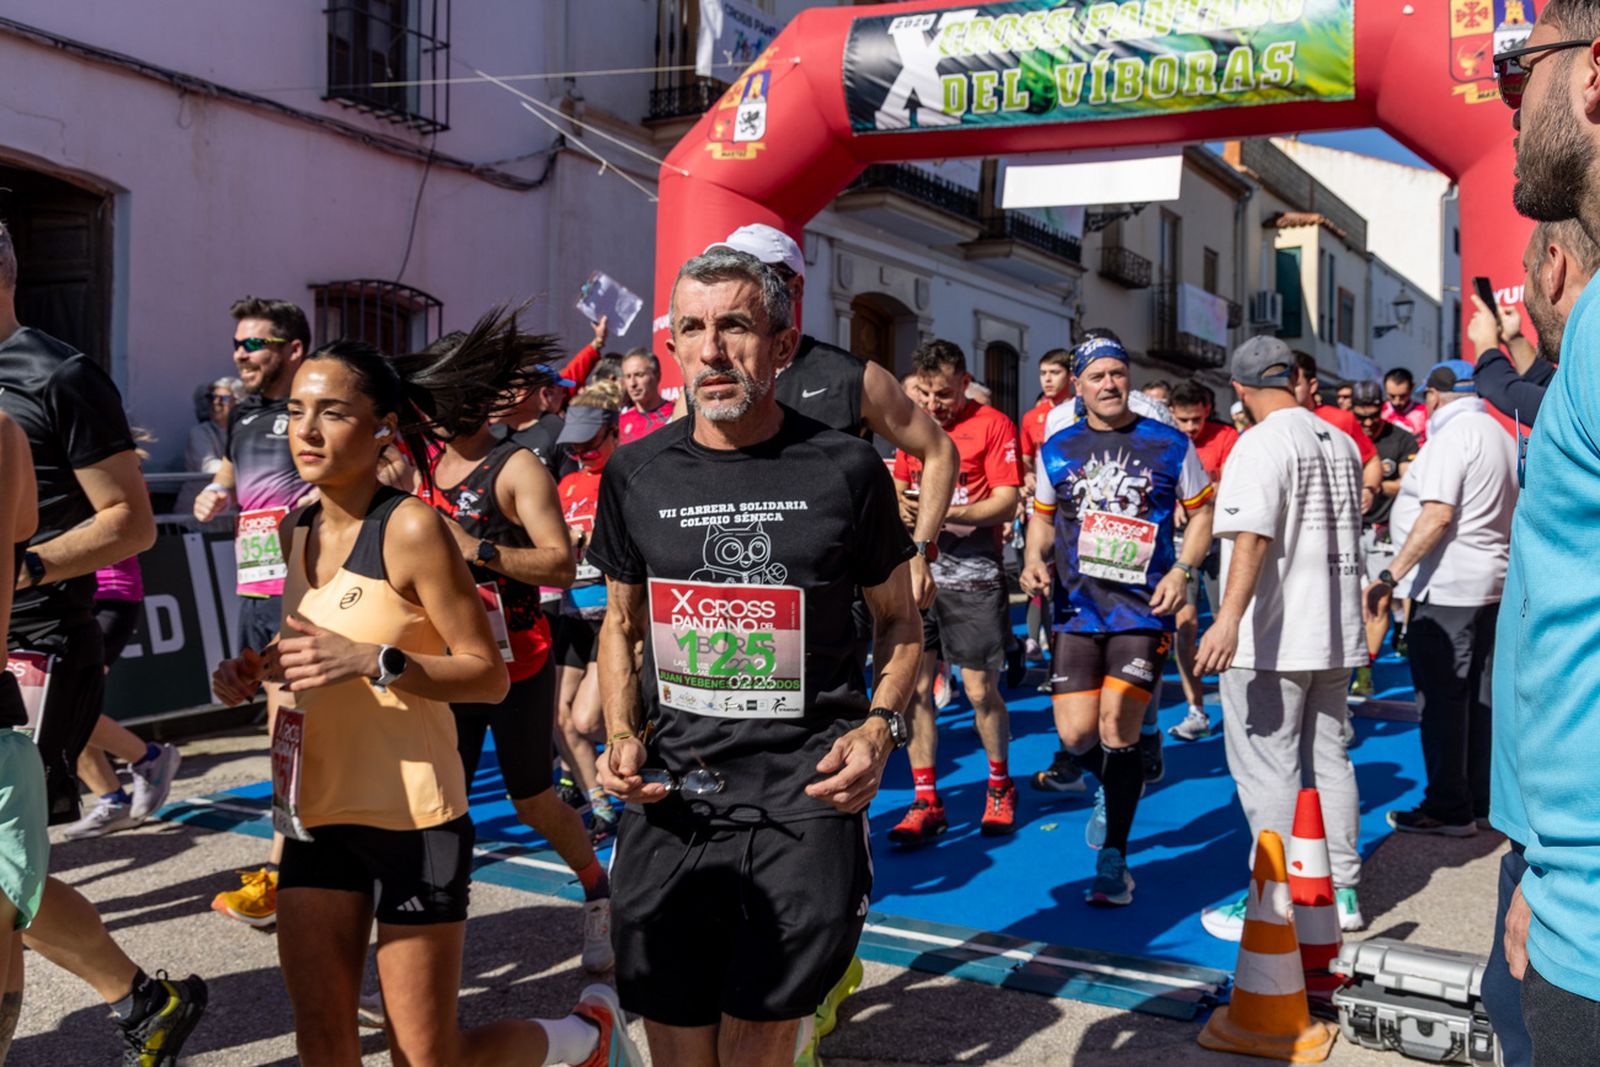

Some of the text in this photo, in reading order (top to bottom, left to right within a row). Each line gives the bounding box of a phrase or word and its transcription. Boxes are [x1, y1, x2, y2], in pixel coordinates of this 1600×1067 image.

[894, 17, 932, 30] 2026
[874, 0, 1304, 130] X CROSS PANTANO
[941, 41, 1296, 116] DEL VÍBORAS
[659, 500, 808, 519] VII CARRERA SOLIDARIA
[680, 512, 784, 528] COLEGIO SÉNECA
[671, 588, 695, 615] X
[698, 598, 777, 619] CROSS
[671, 614, 776, 634] PANTANO DEL
[678, 629, 777, 677] 125
[659, 670, 683, 683] JUAN
